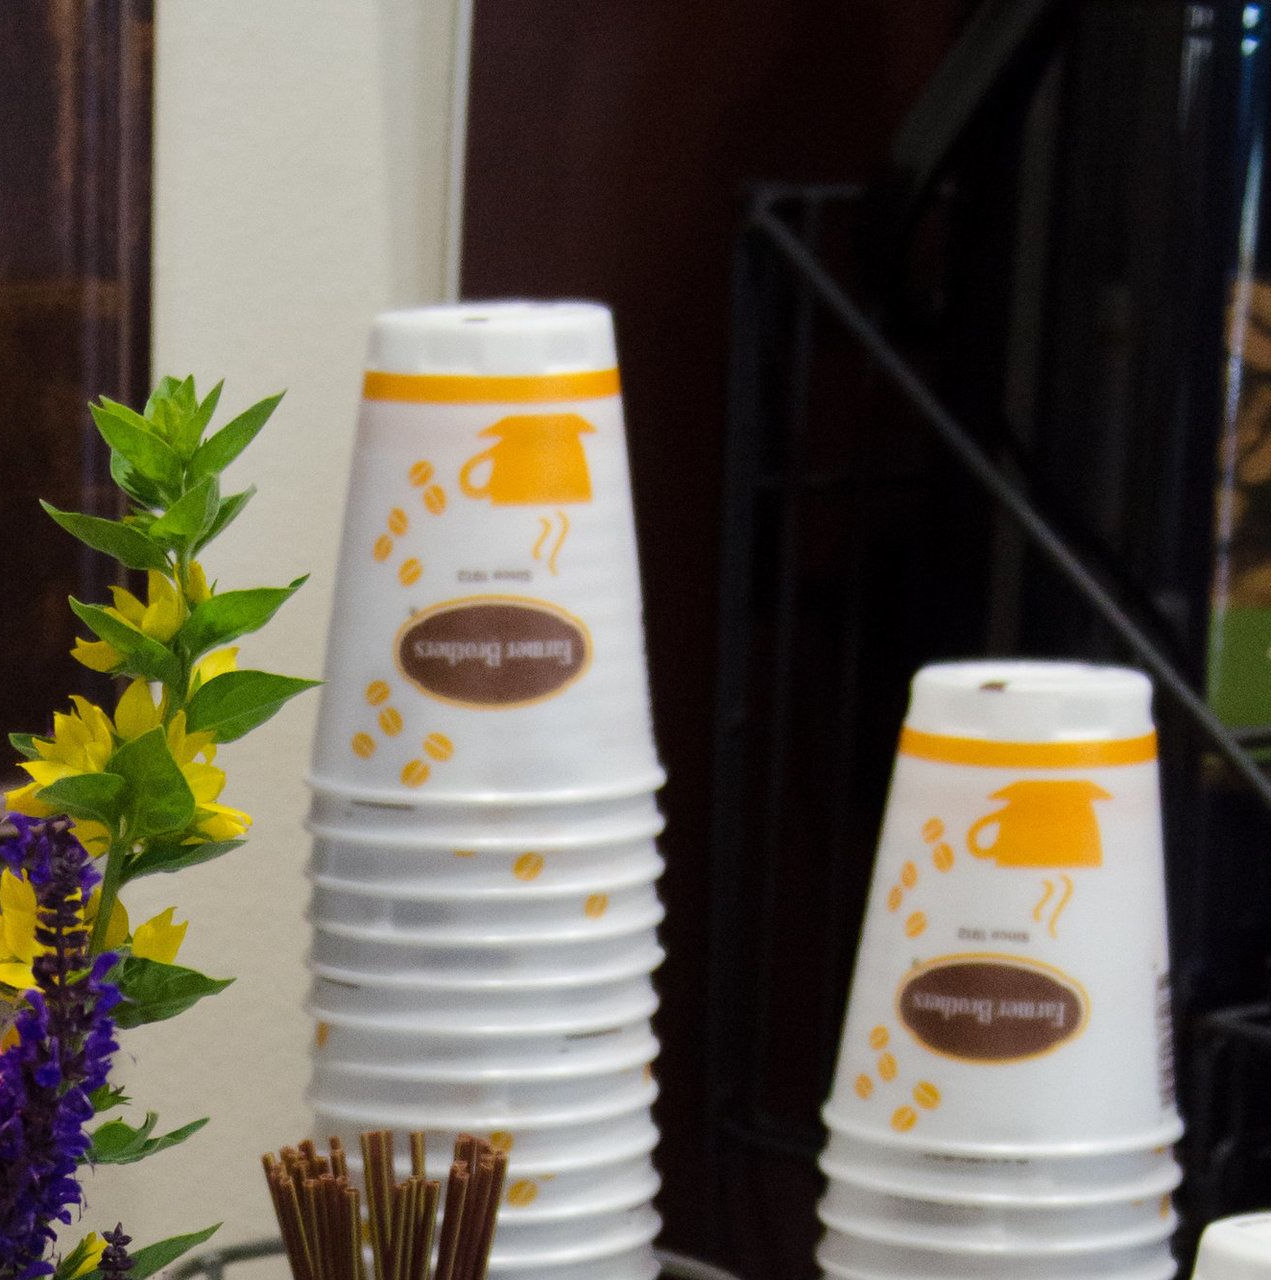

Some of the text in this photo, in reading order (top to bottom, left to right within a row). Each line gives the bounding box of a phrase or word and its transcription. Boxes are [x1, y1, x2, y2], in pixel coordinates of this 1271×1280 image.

[414, 639, 573, 668] Farmer Brothers
[912, 991, 1066, 1028] Farmer Brothers
